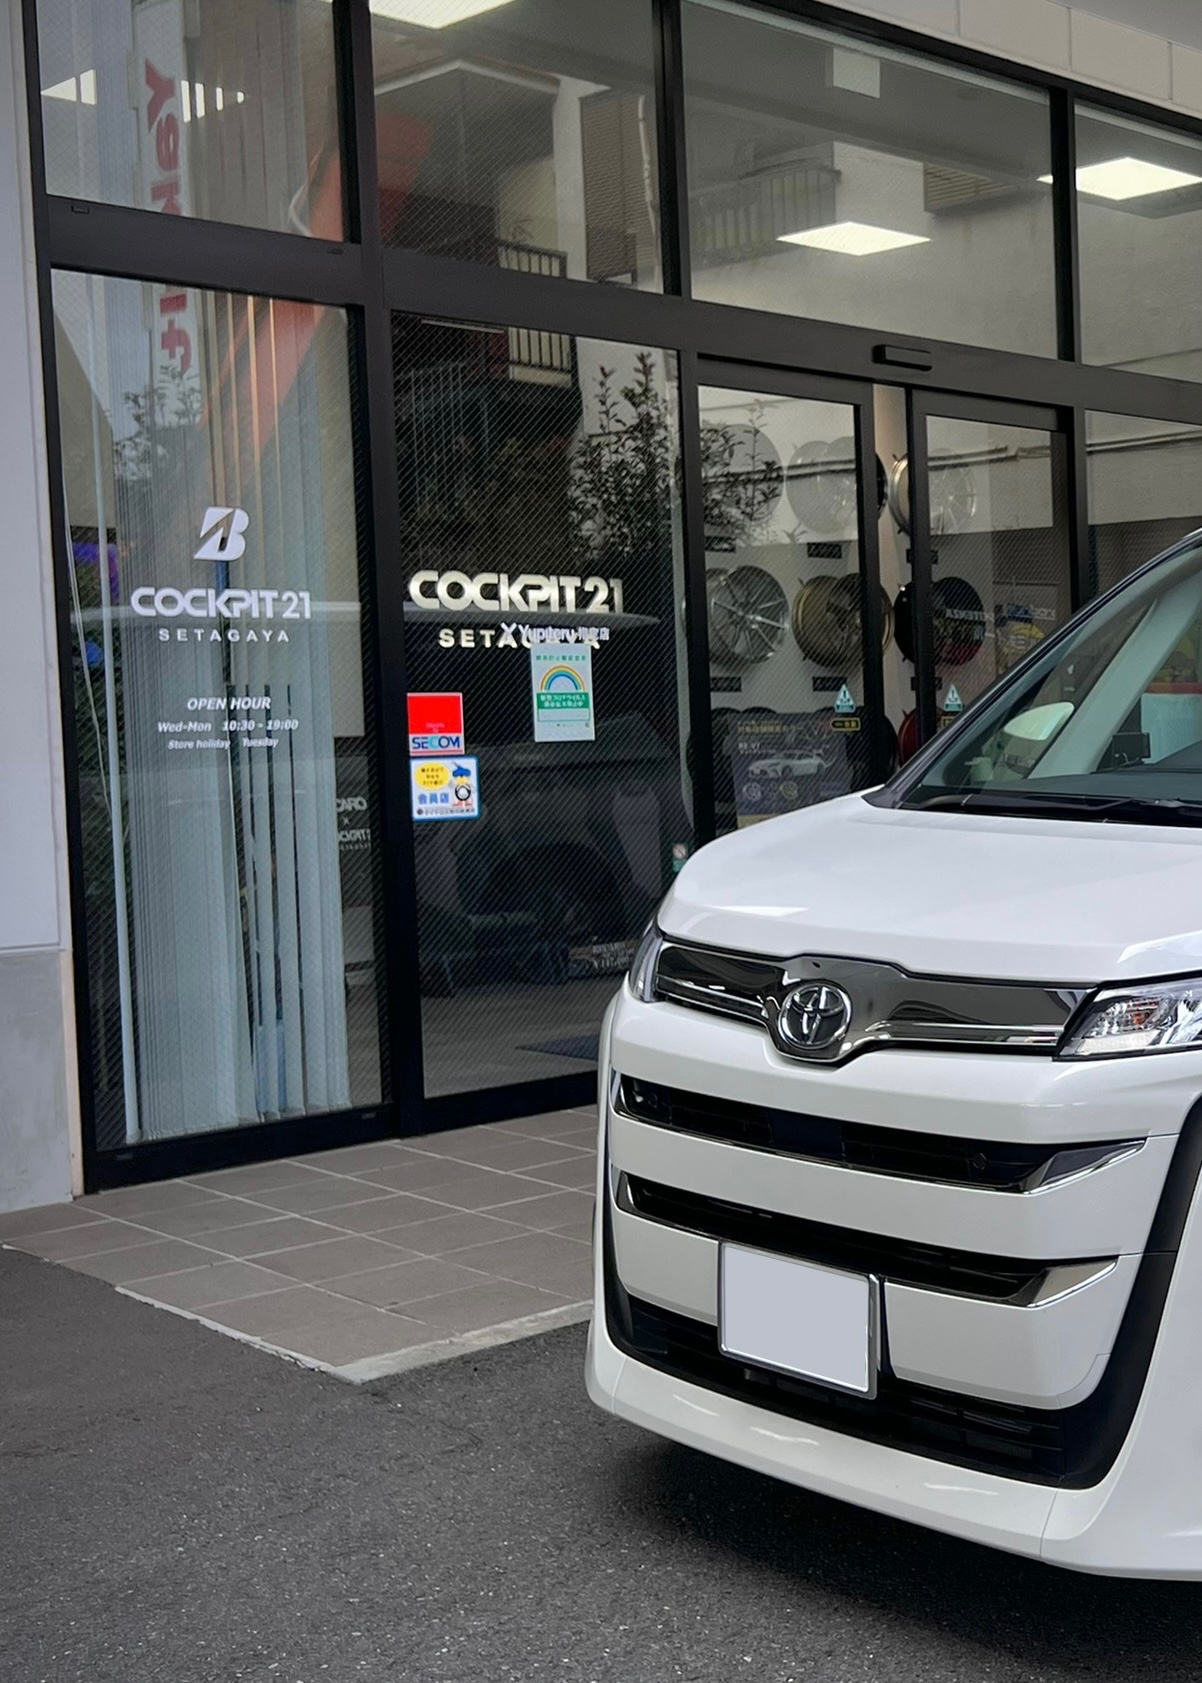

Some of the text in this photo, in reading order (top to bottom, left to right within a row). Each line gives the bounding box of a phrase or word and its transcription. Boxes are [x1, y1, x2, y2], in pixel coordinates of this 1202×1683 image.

[159, 629, 290, 642] SETAGAYA
[187, 698, 271, 710] OPEN HOUR
[158, 722, 211, 733] Wed-Mon
[222, 720, 255, 731] 10:30
[267, 720, 299, 730] 19:00
[168, 738, 279, 750] Store holiday Tuesday
[412, 735, 460, 749] SECOM
